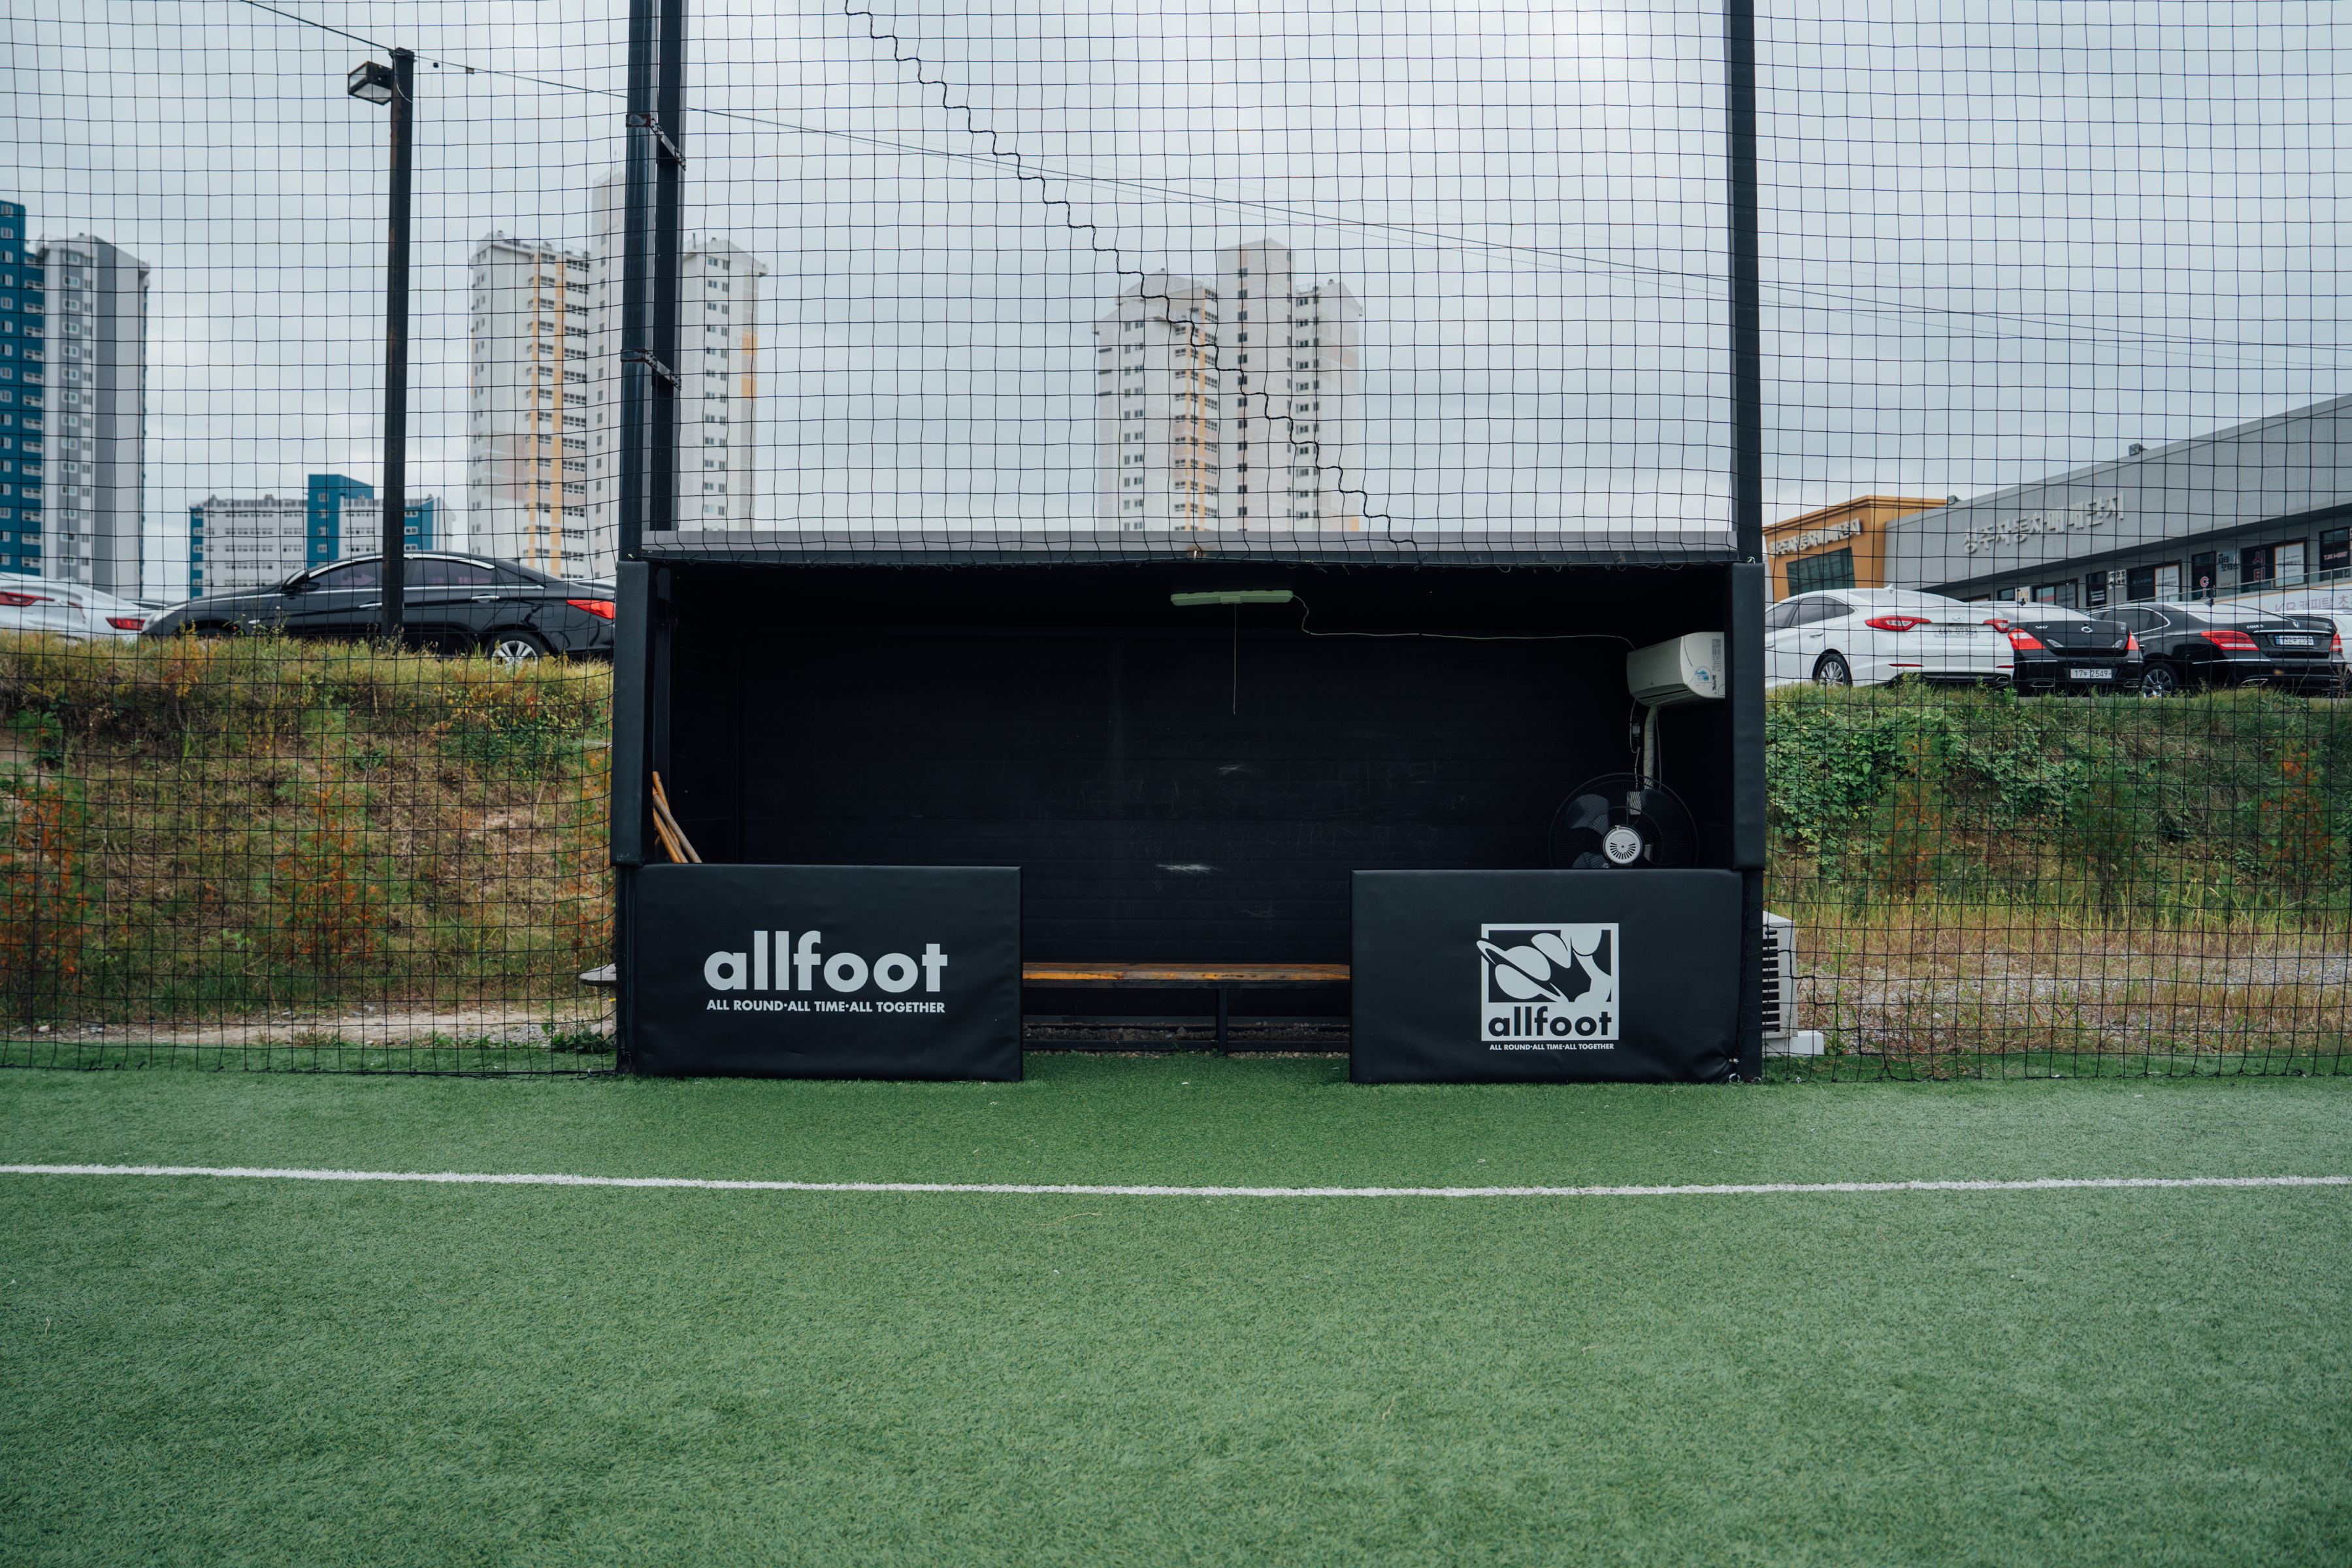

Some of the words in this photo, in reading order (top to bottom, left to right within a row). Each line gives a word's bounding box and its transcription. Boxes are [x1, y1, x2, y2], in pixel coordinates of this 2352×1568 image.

[1768, 518, 1861, 558] 청주자동차매매단지
[1962, 491, 2124, 554] 청주자동차매매단지
[2338, 595, 2352, 609] 초
[704, 930, 948, 993] allfoot
[707, 1000, 730, 1011] ALL
[876, 1002, 945, 1013] TOGETHER
[1488, 1005, 1612, 1037] allfoot
